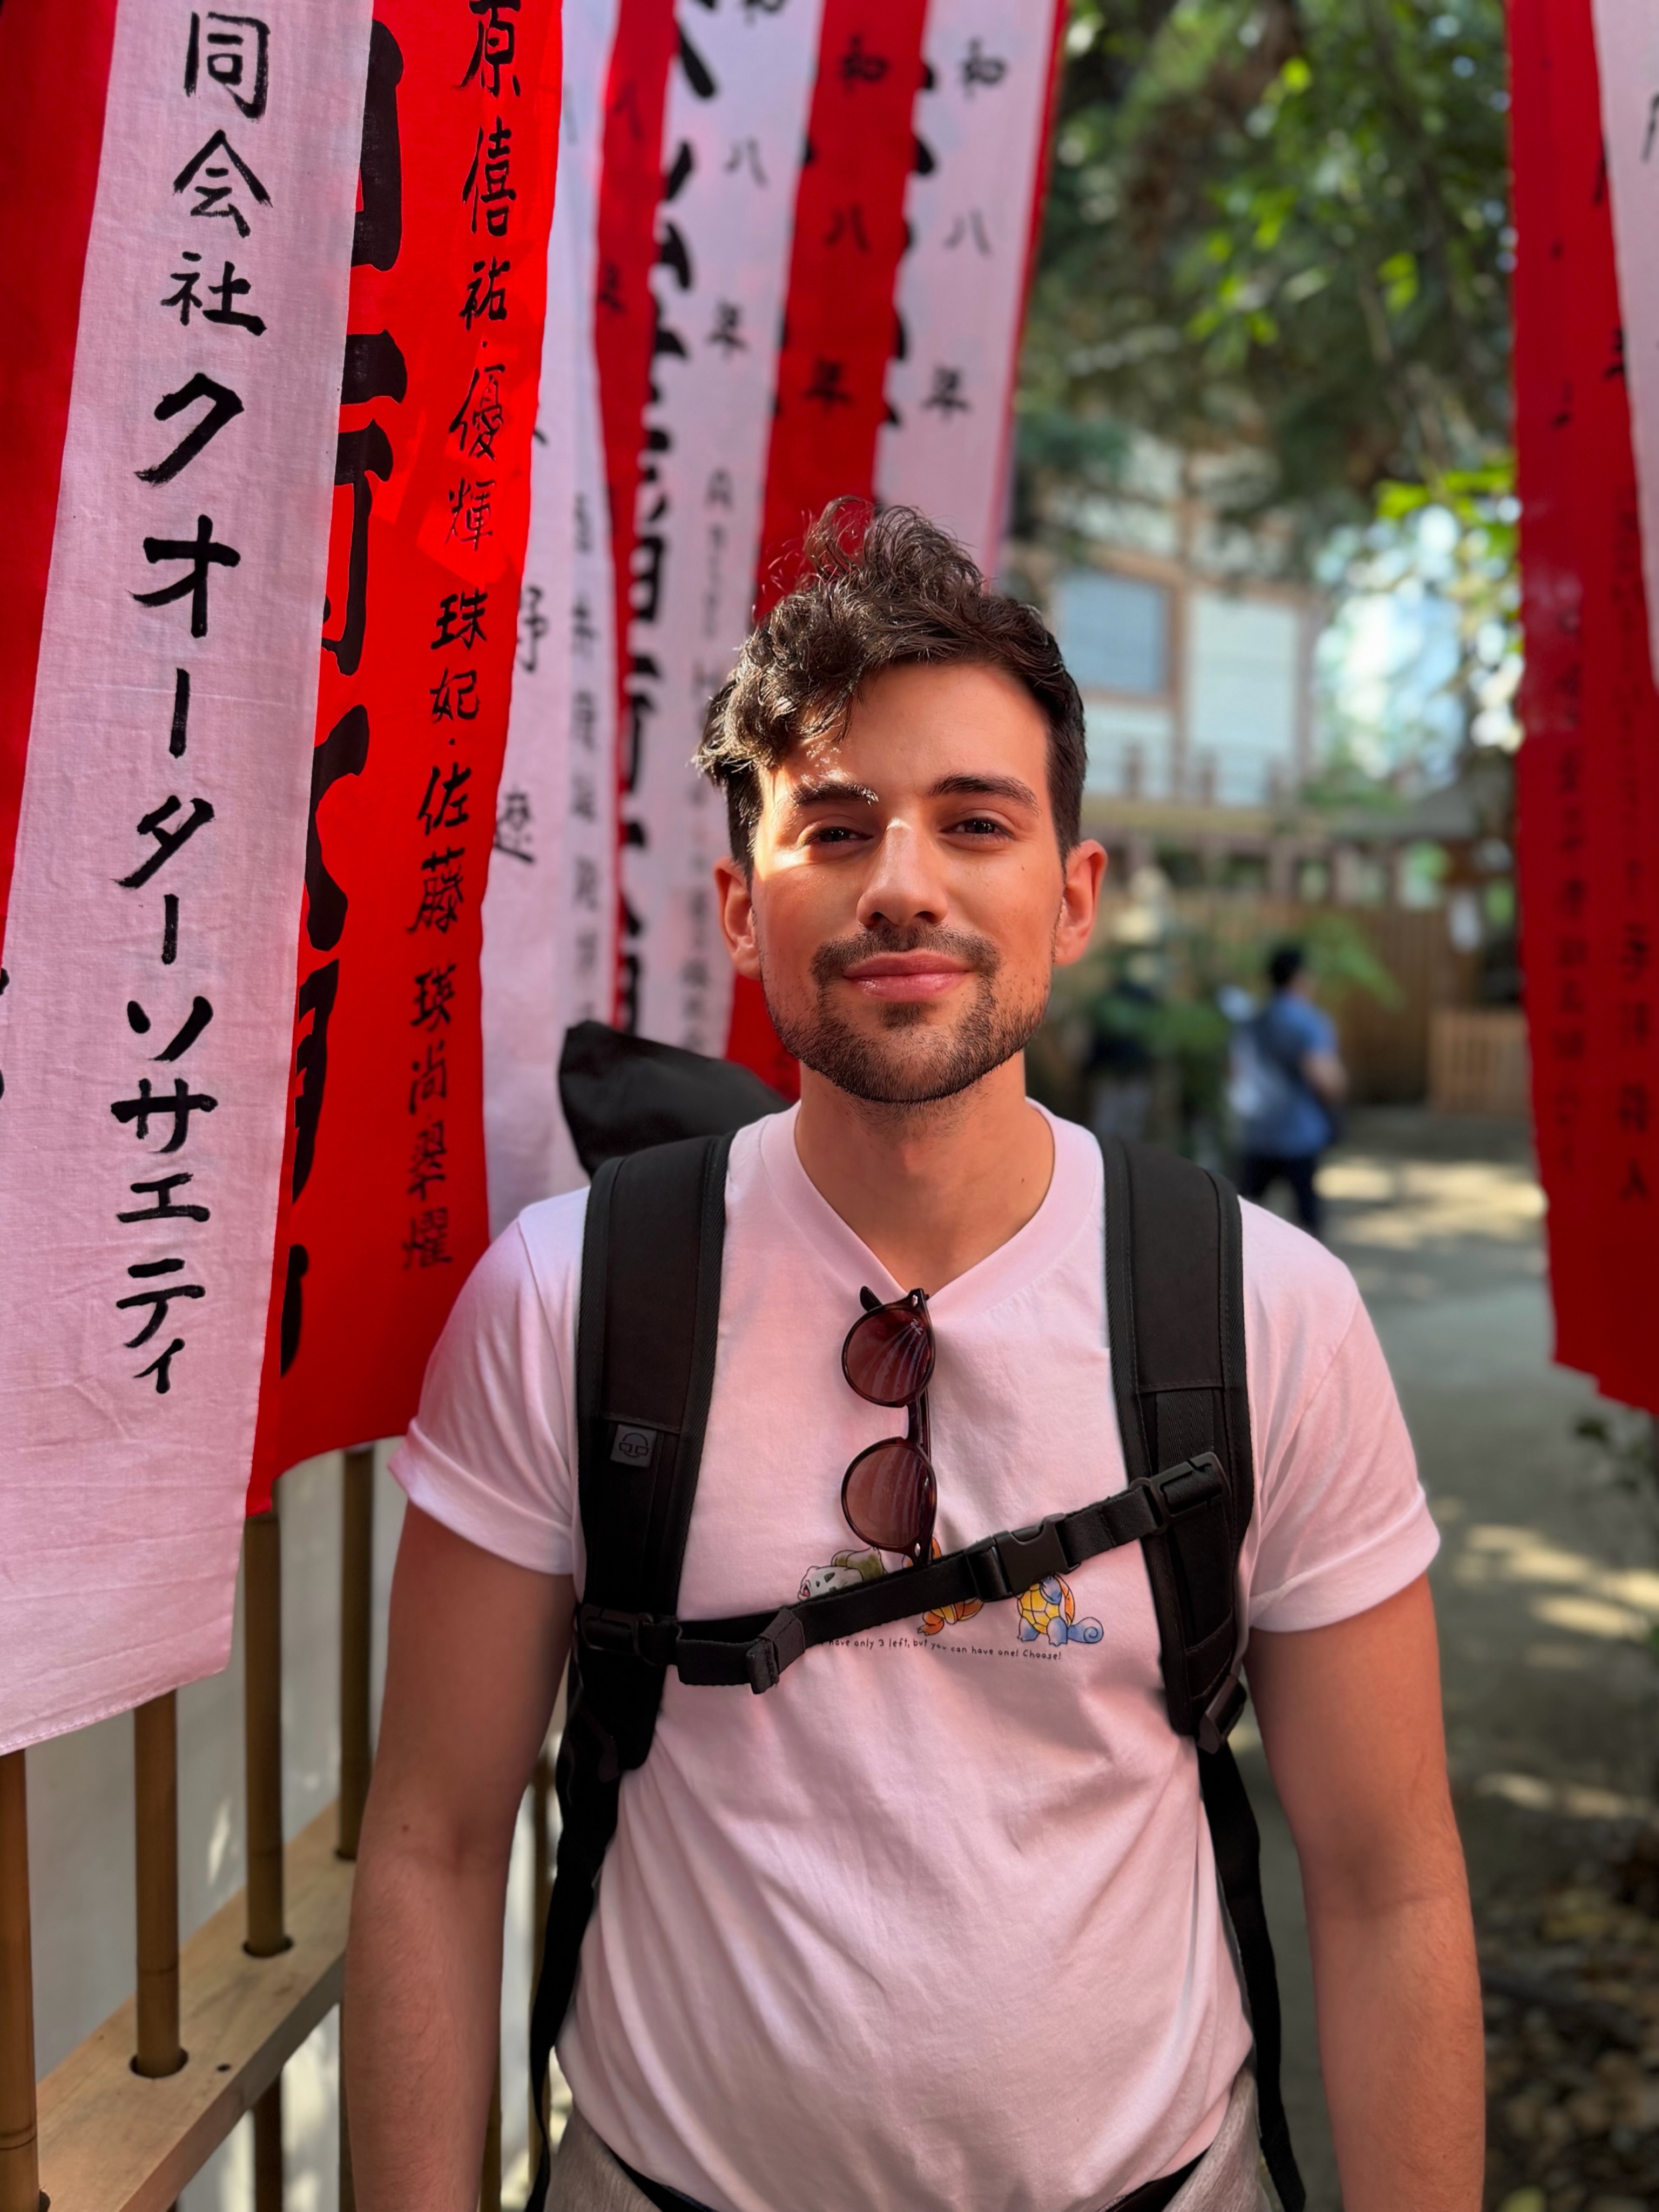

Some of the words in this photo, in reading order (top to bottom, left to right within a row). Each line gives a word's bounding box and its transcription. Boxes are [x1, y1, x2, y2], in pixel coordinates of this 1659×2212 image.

[854, 1637, 874, 1650] only
[878, 1638, 885, 1647] 3
[888, 1637, 910, 1648] left,
[913, 1638, 928, 1647] but
[931, 1641, 947, 1650] you
[972, 1645, 993, 1655] have
[997, 1648, 1019, 1657] one!
[1022, 1649, 1062, 1660] Choose!
